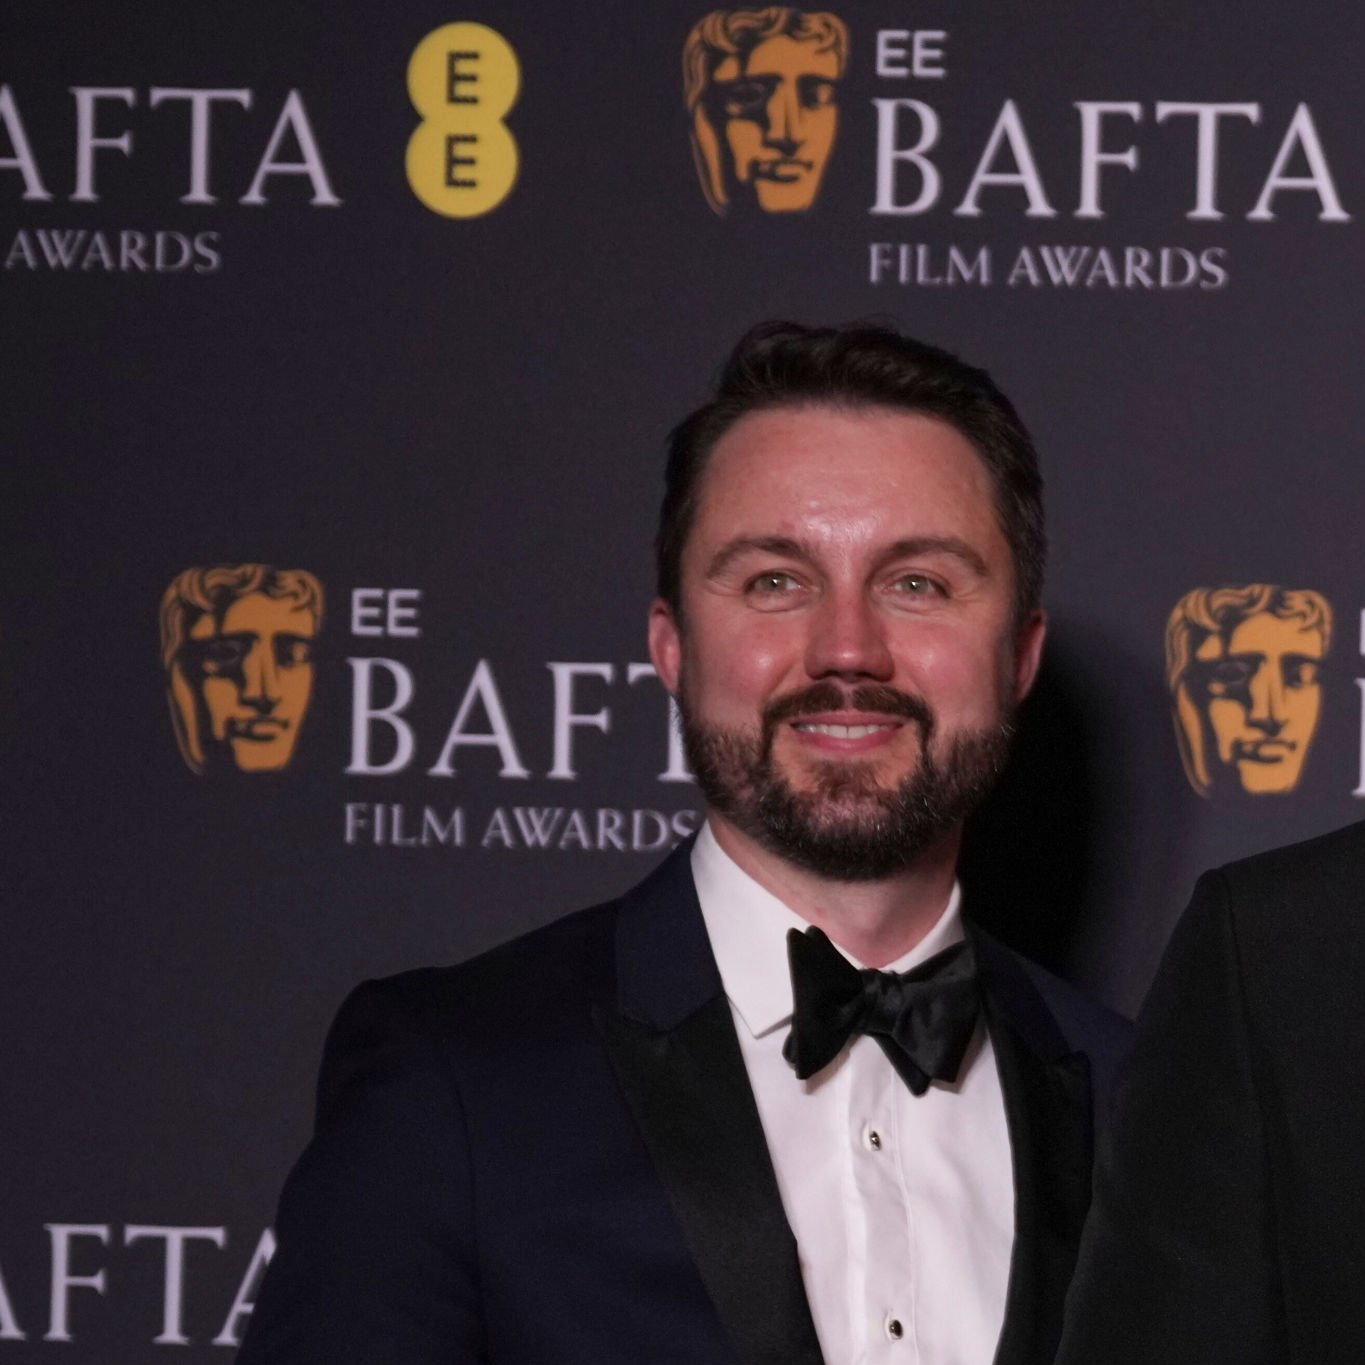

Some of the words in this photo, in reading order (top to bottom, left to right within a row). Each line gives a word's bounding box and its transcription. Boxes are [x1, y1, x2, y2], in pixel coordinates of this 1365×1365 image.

[877, 30, 946, 77] EE
[870, 98, 1351, 222] BAFTA
[7, 230, 219, 271] AWARDS
[870, 244, 989, 285] FILM
[1009, 246, 1226, 287] AWARDS
[352, 588, 420, 636] EE
[346, 804, 463, 845] FILM
